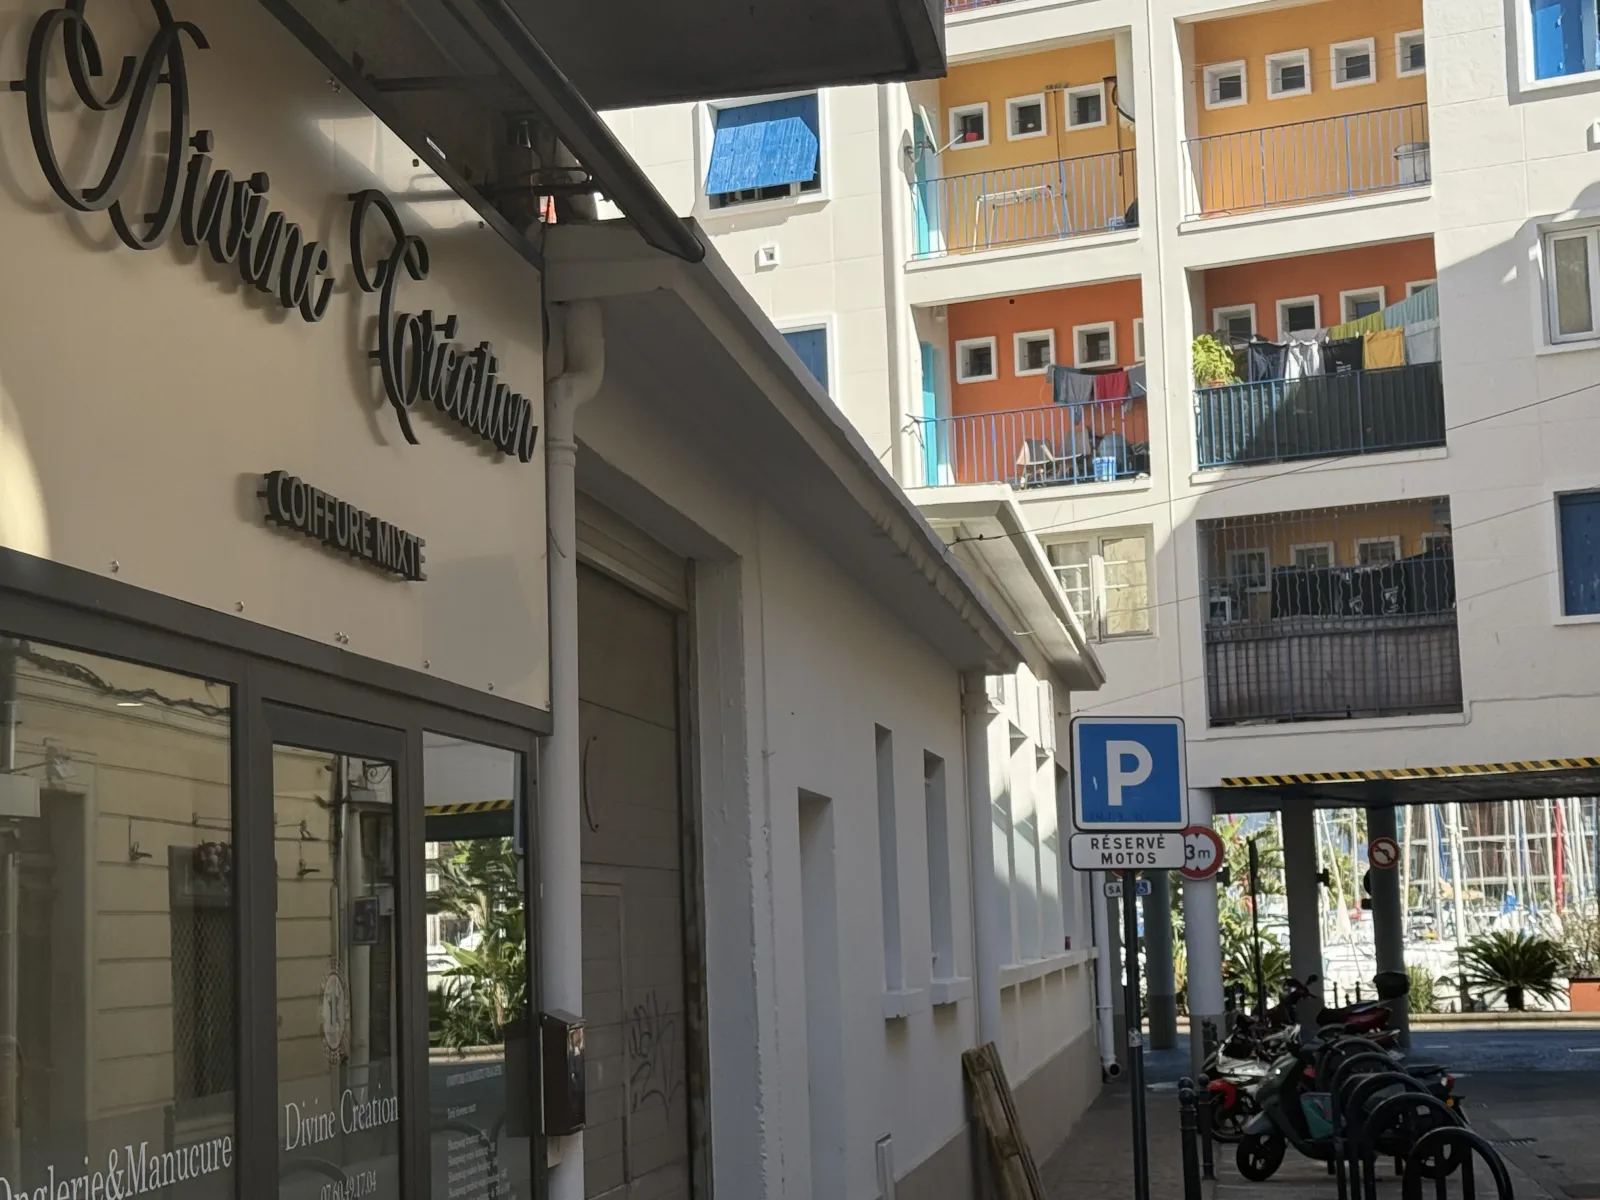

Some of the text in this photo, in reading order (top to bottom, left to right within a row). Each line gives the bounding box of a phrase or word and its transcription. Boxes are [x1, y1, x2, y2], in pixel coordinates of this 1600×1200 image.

[268, 470, 427, 581] COIFFURE MIXTE
[1106, 740, 1153, 806] P
[1090, 833, 1166, 850] RÉSERVÉ
[1101, 852, 1157, 865] MOTOS
[284, 1083, 399, 1151] Divine Création
